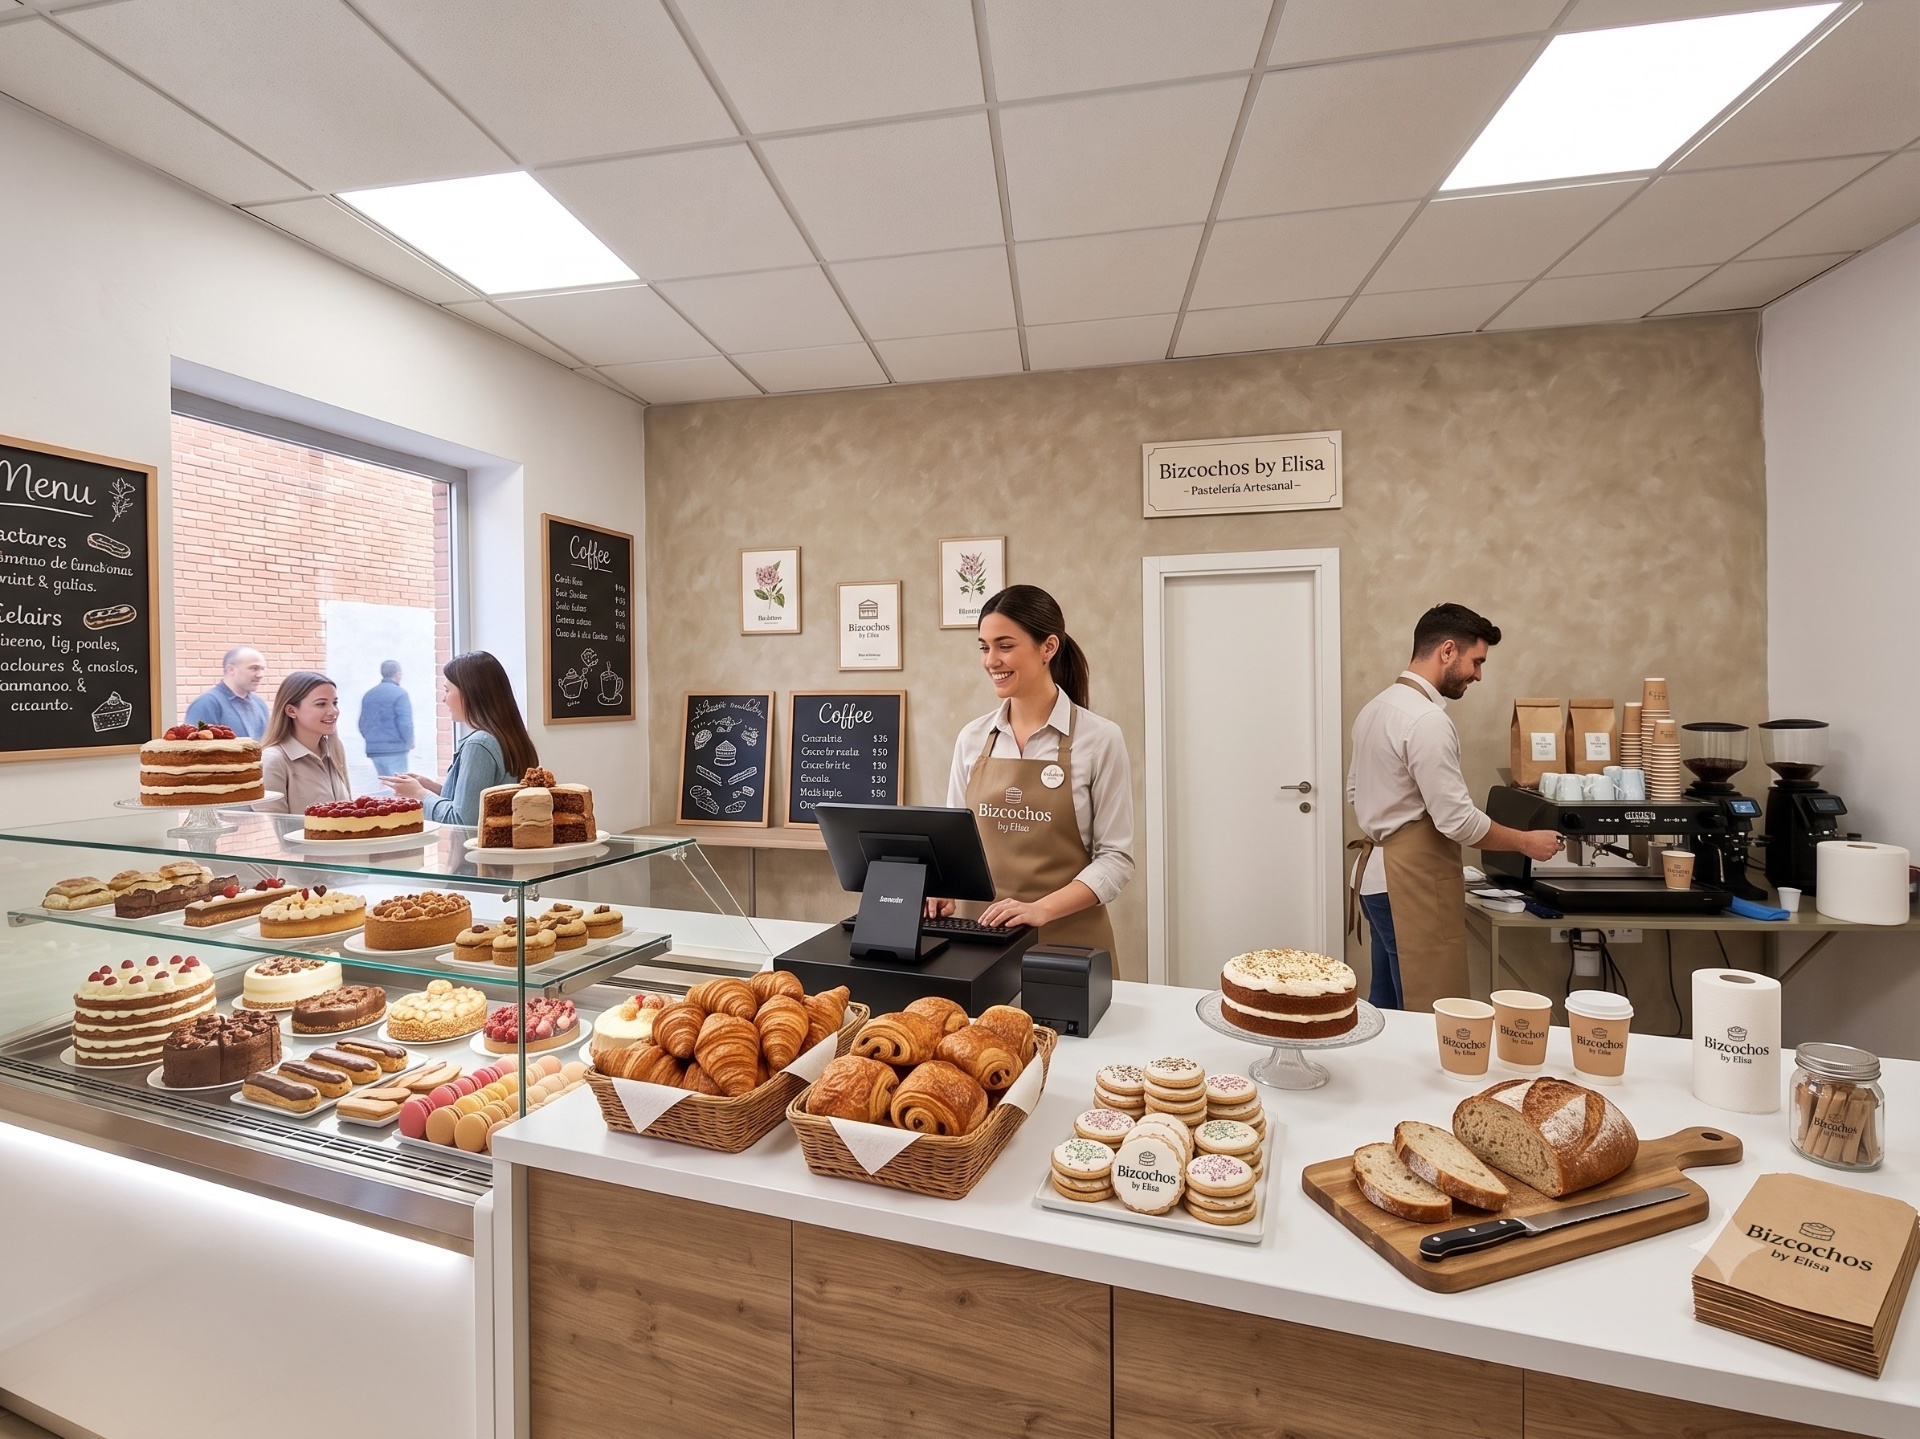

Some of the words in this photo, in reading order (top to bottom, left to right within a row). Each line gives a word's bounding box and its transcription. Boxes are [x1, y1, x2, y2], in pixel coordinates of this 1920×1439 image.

[1159, 460, 1250, 480] Bizcochos
[1255, 457, 1276, 477] by
[1281, 455, 1325, 473] Elisa
[0, 459, 97, 506] Menu
[569, 534, 611, 571] Coffee
[50, 555, 68, 570] de
[38, 574, 49, 589] &
[848, 622, 890, 632] Bizcochos
[819, 702, 874, 730] Coffee
[978, 803, 1052, 822] Bizcochos
[997, 821, 1008, 834] by
[1500, 1025, 1545, 1039] Bizcochos
[1442, 1035, 1487, 1050] Bizcochos
[1576, 1035, 1624, 1050] Bizcochos
[1704, 1035, 1770, 1056] Bizcochos
[1720, 1053, 1732, 1063] by
[1732, 1055, 1753, 1065] Elisa
[1117, 1164, 1176, 1185] Bizcochos
[1131, 1181, 1141, 1191] by
[1142, 1181, 1160, 1192] Elisa
[1746, 1223, 1874, 1272] Bizcochos
[1770, 1249, 1790, 1262] by
[1793, 1255, 1830, 1273] Elisa
